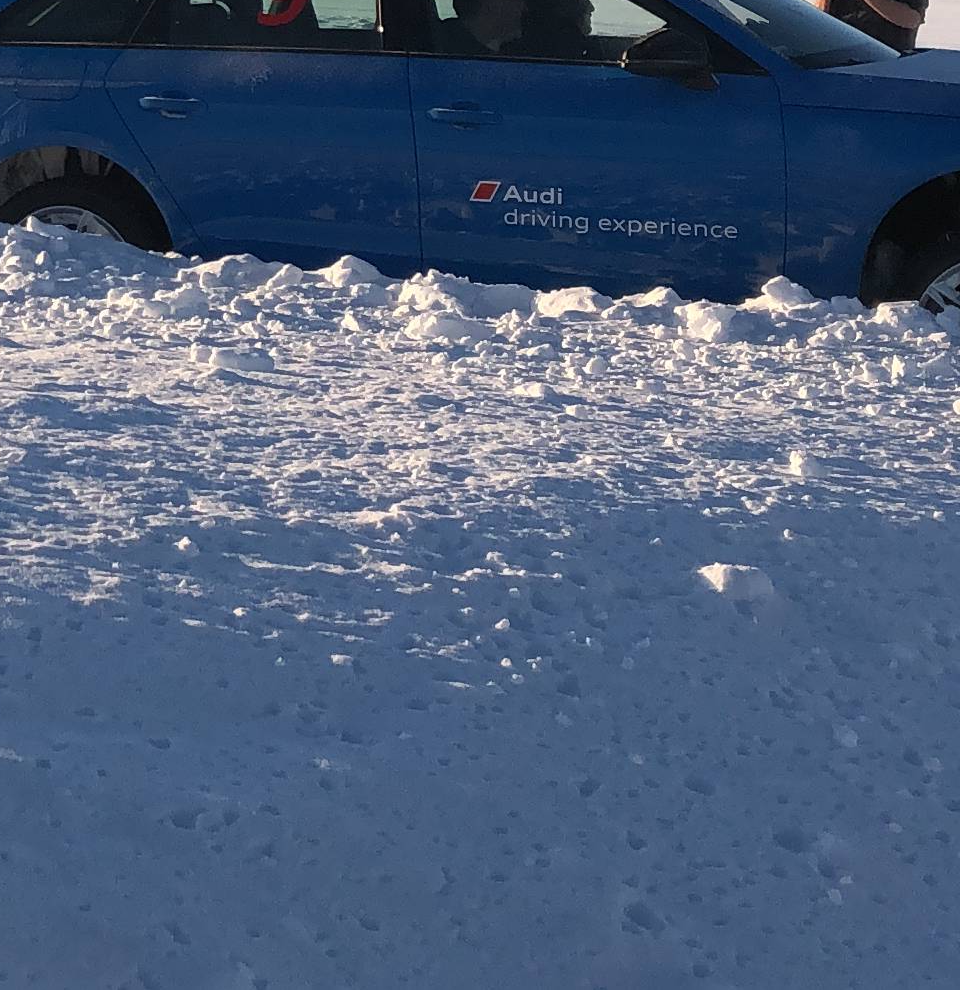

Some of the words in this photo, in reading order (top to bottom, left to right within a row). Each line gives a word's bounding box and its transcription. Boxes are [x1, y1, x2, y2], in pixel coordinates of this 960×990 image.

[503, 185, 563, 205] Audi
[503, 209, 589, 234] driving
[598, 217, 739, 239] experience
